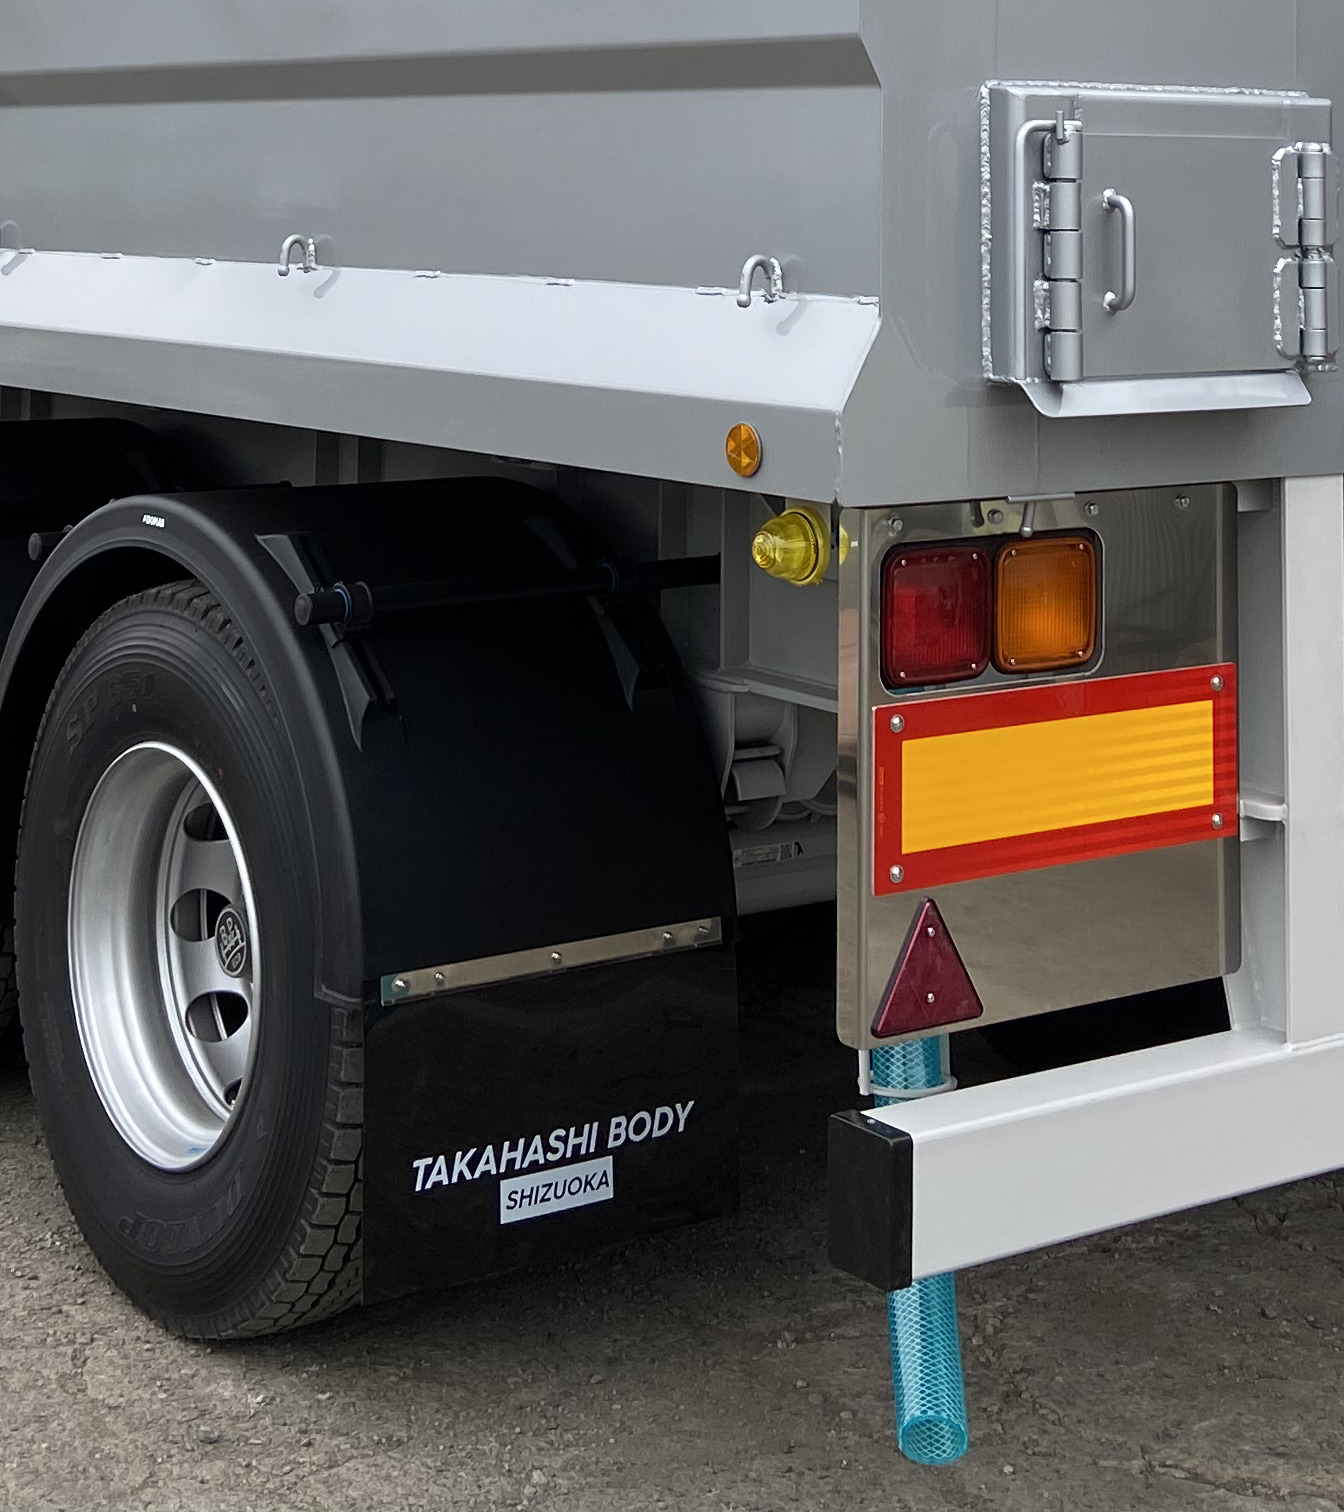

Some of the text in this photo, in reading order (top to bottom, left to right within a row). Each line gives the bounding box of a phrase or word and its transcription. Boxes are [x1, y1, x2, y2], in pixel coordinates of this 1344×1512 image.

[412, 1100, 695, 1192] TAKAHASHI BODY
[506, 1170, 609, 1210] SHIZUOKA
